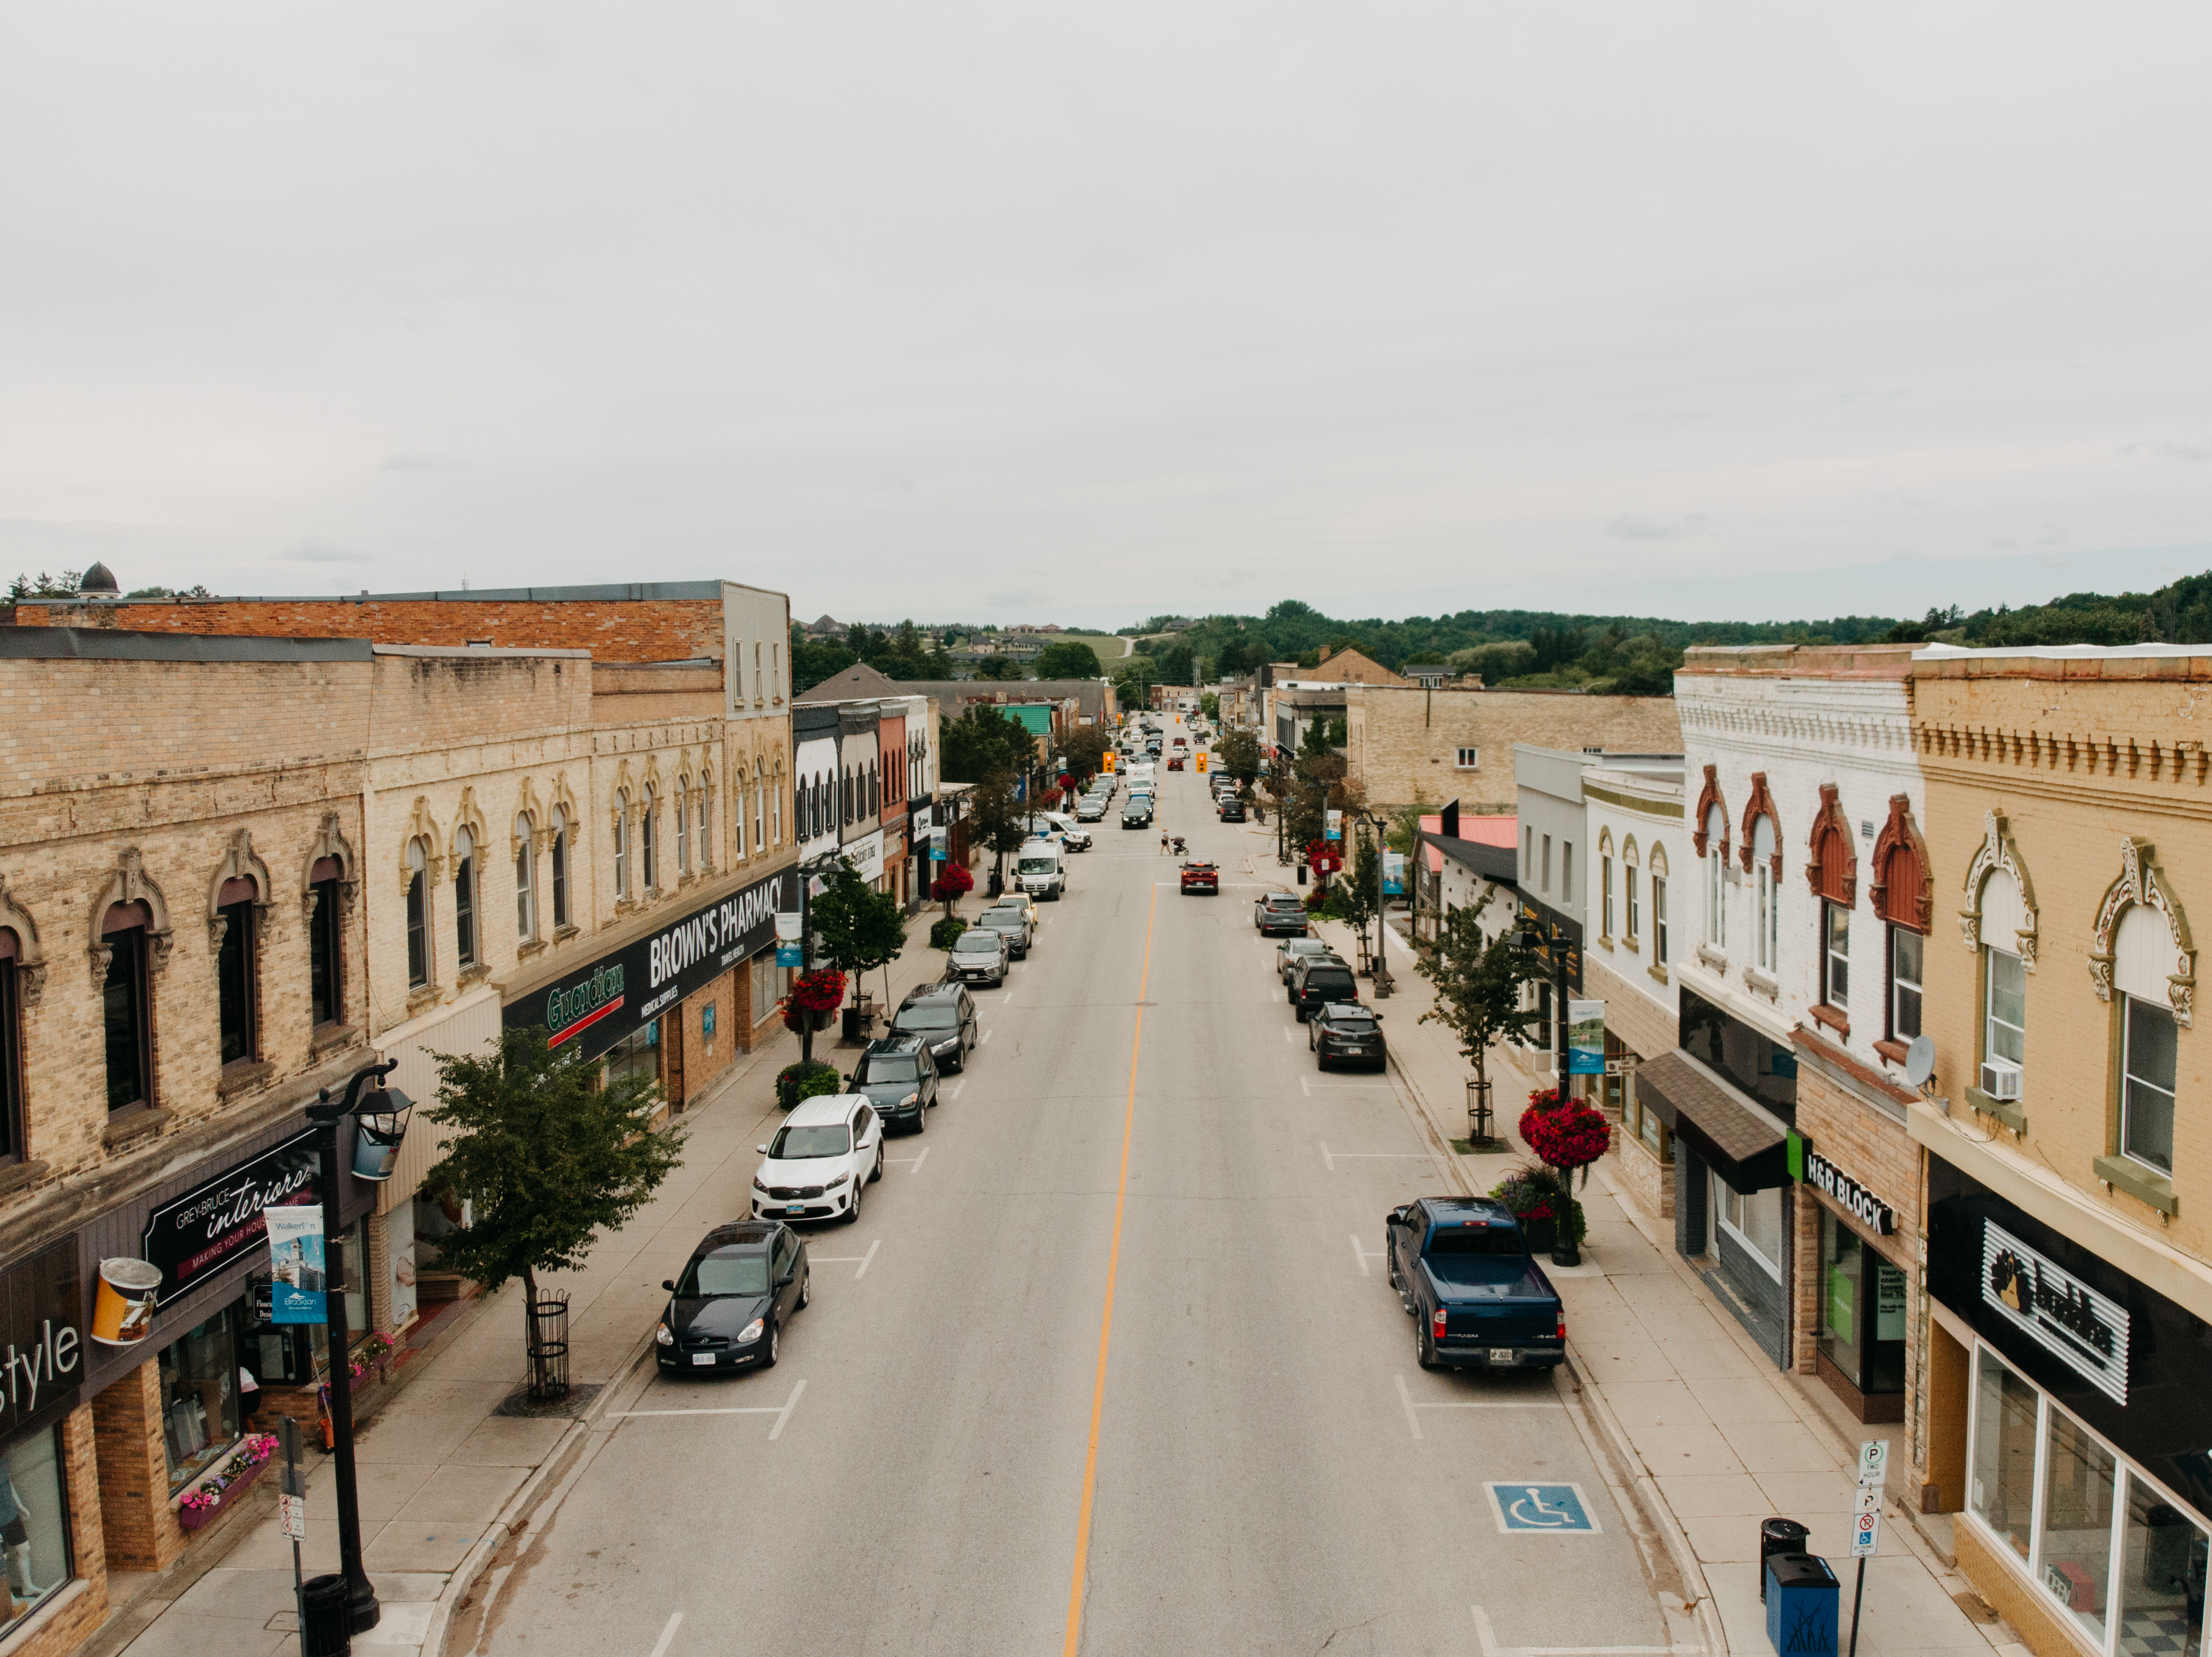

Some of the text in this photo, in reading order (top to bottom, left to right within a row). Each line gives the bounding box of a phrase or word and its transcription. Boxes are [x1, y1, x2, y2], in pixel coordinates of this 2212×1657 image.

[650, 875, 783, 989] BROWN'S PHARMACY
[547, 963, 624, 1031] Guardian
[641, 985, 678, 1019] MEDICAL SUPPLIES
[176, 1188, 230, 1229] GREY-BRUCE
[207, 1166, 309, 1238] interiors
[1808, 1154, 1882, 1235] H&R BLOCK
[192, 1243, 222, 1268] MAKING
[224, 1230, 244, 1249] YOUR
[246, 1217, 267, 1236] HOUS
[0, 1319, 79, 1414] tyle
[1869, 1448, 1878, 1460] P
